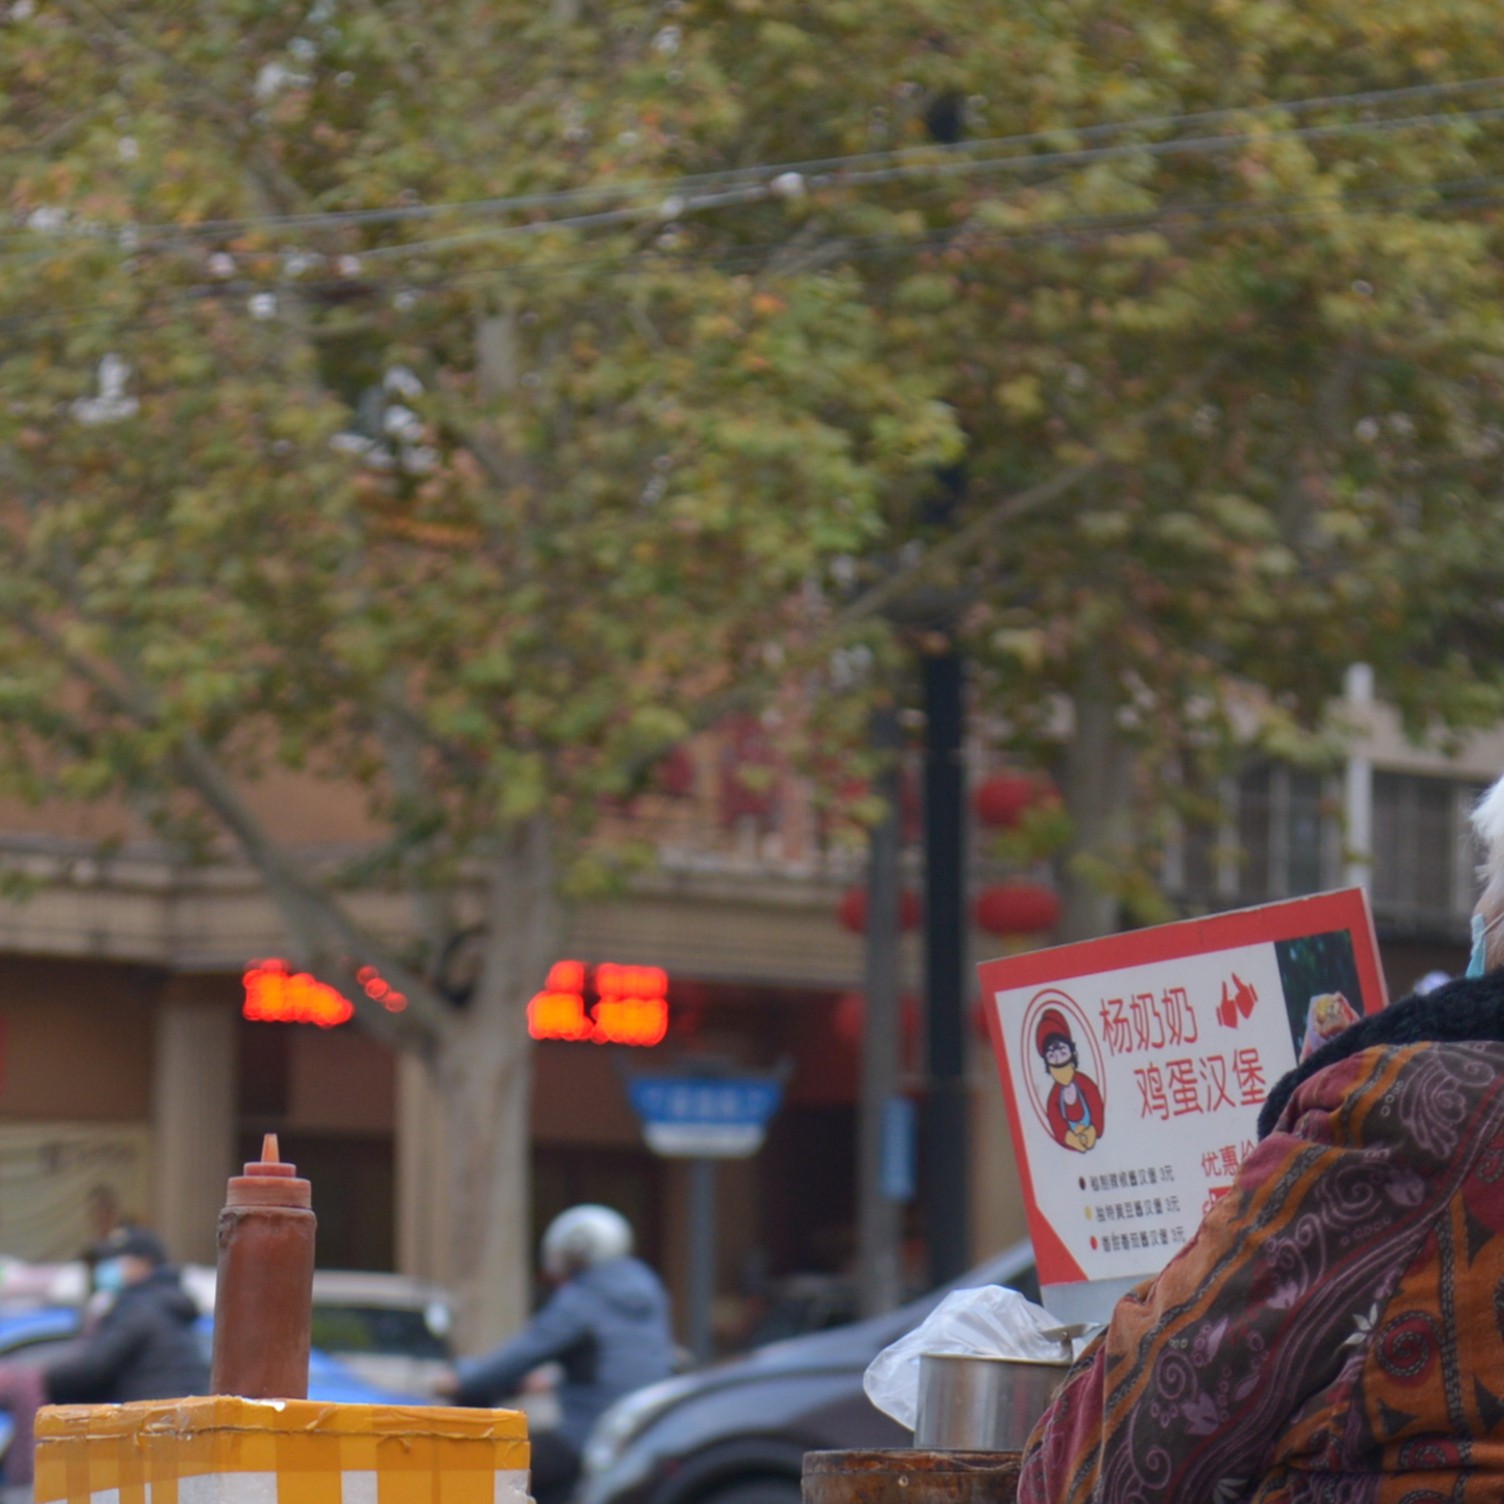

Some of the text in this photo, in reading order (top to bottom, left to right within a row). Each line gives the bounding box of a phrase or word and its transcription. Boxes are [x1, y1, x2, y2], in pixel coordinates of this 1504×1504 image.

[1099, 986, 1198, 1056] 杨奶奶
[1133, 1048, 1268, 1121] 鸡蛋汉堡
